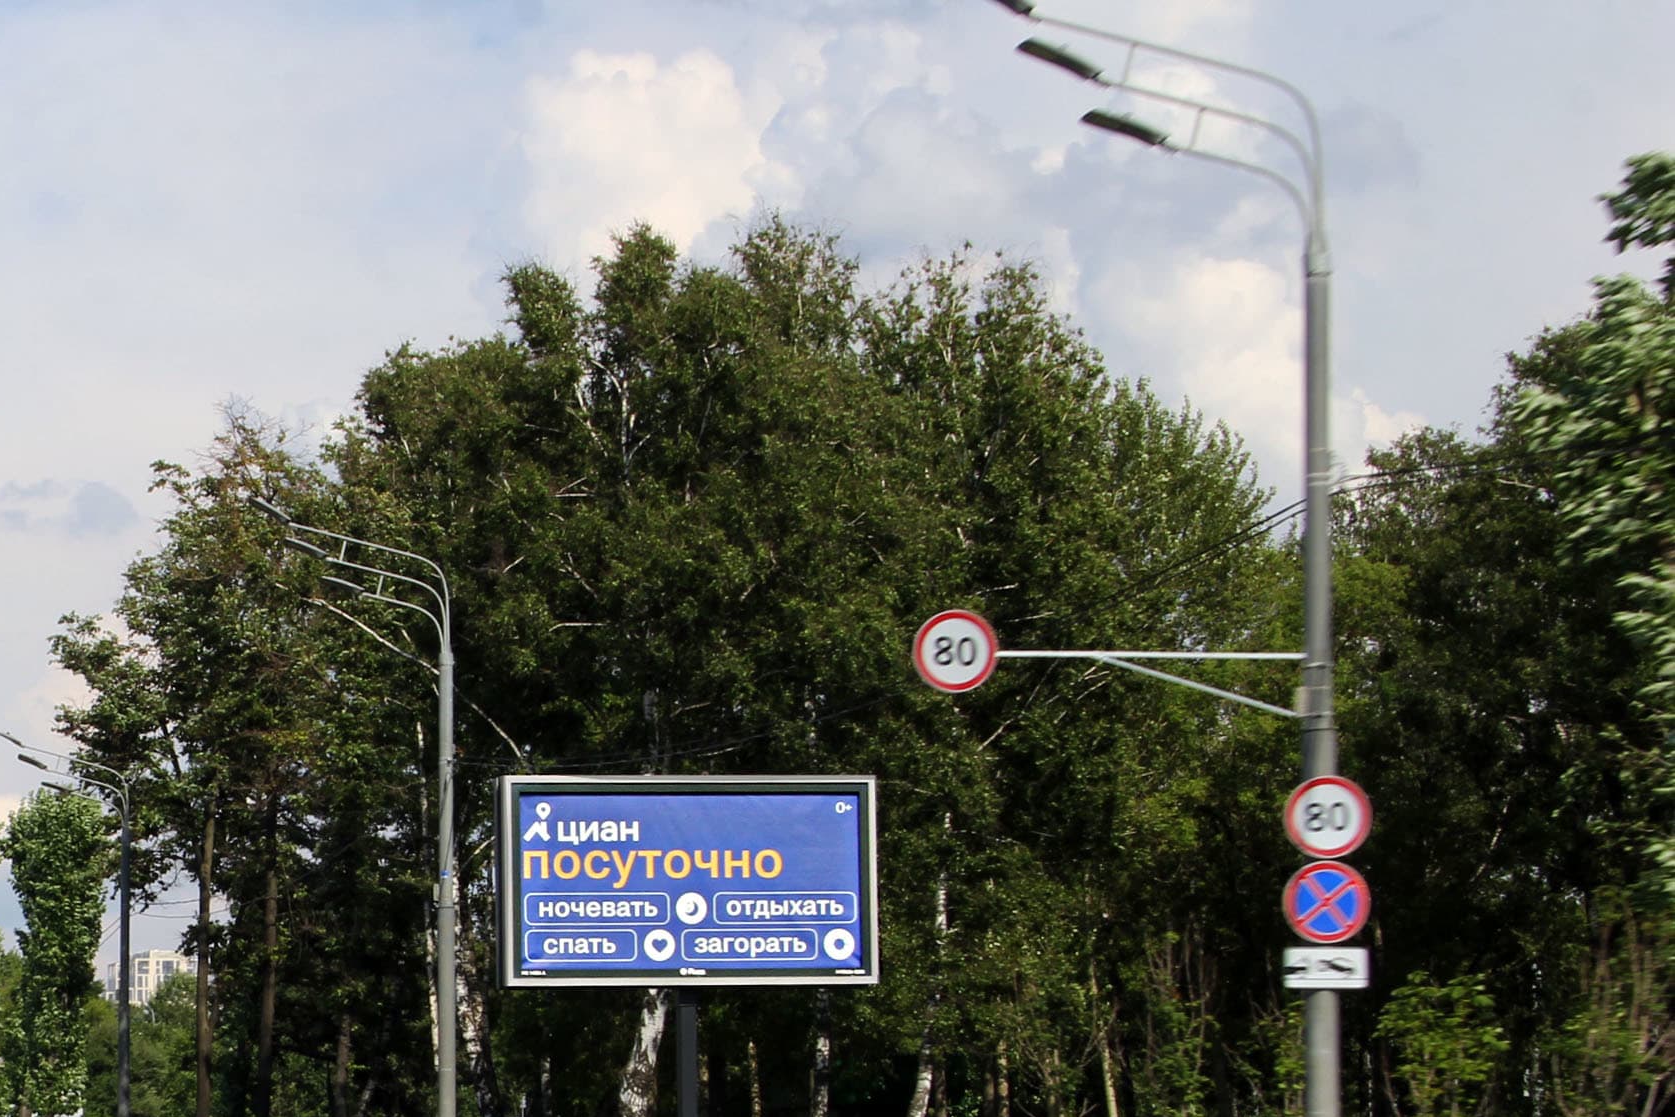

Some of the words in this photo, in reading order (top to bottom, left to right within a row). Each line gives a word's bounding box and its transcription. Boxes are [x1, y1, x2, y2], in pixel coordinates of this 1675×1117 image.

[934, 636, 976, 666] 80
[835, 801, 853, 814] 0+
[1304, 801, 1348, 832] 80
[558, 820, 640, 845] циан
[523, 848, 784, 888] посуточно
[538, 901, 658, 918] ночевать
[726, 899, 844, 920] отдыхать
[543, 937, 616, 955] спать
[694, 937, 807, 957] загорать
